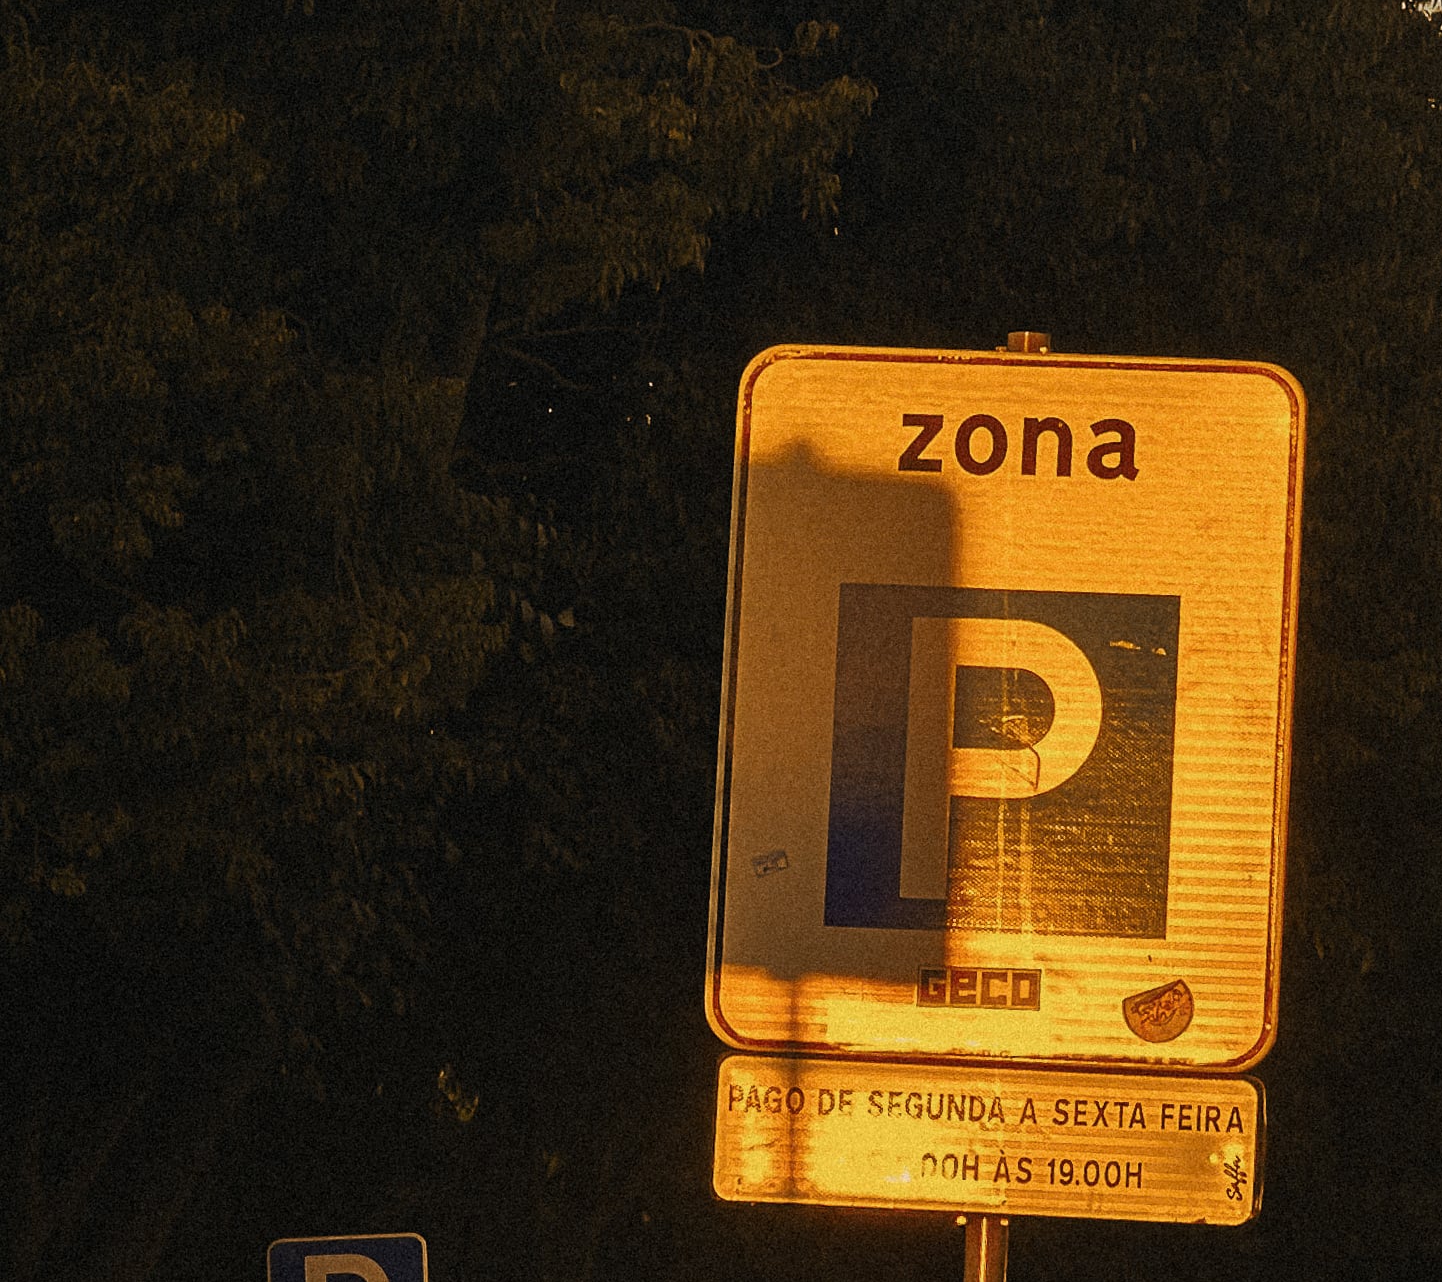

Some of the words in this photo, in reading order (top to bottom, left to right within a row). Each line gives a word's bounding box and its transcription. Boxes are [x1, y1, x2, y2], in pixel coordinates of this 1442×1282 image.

[898, 413, 1140, 481] zona
[900, 617, 1103, 901] P
[728, 1084, 806, 1116] PAGO
[867, 1090, 1006, 1124] SEGUNDA
[1019, 1098, 1038, 1125] A
[1052, 1099, 1147, 1130] SEXTA
[1161, 1104, 1244, 1134] FEIRA
[993, 1150, 1033, 1185] ÀS
[1047, 1158, 1143, 1189] 19.00H
